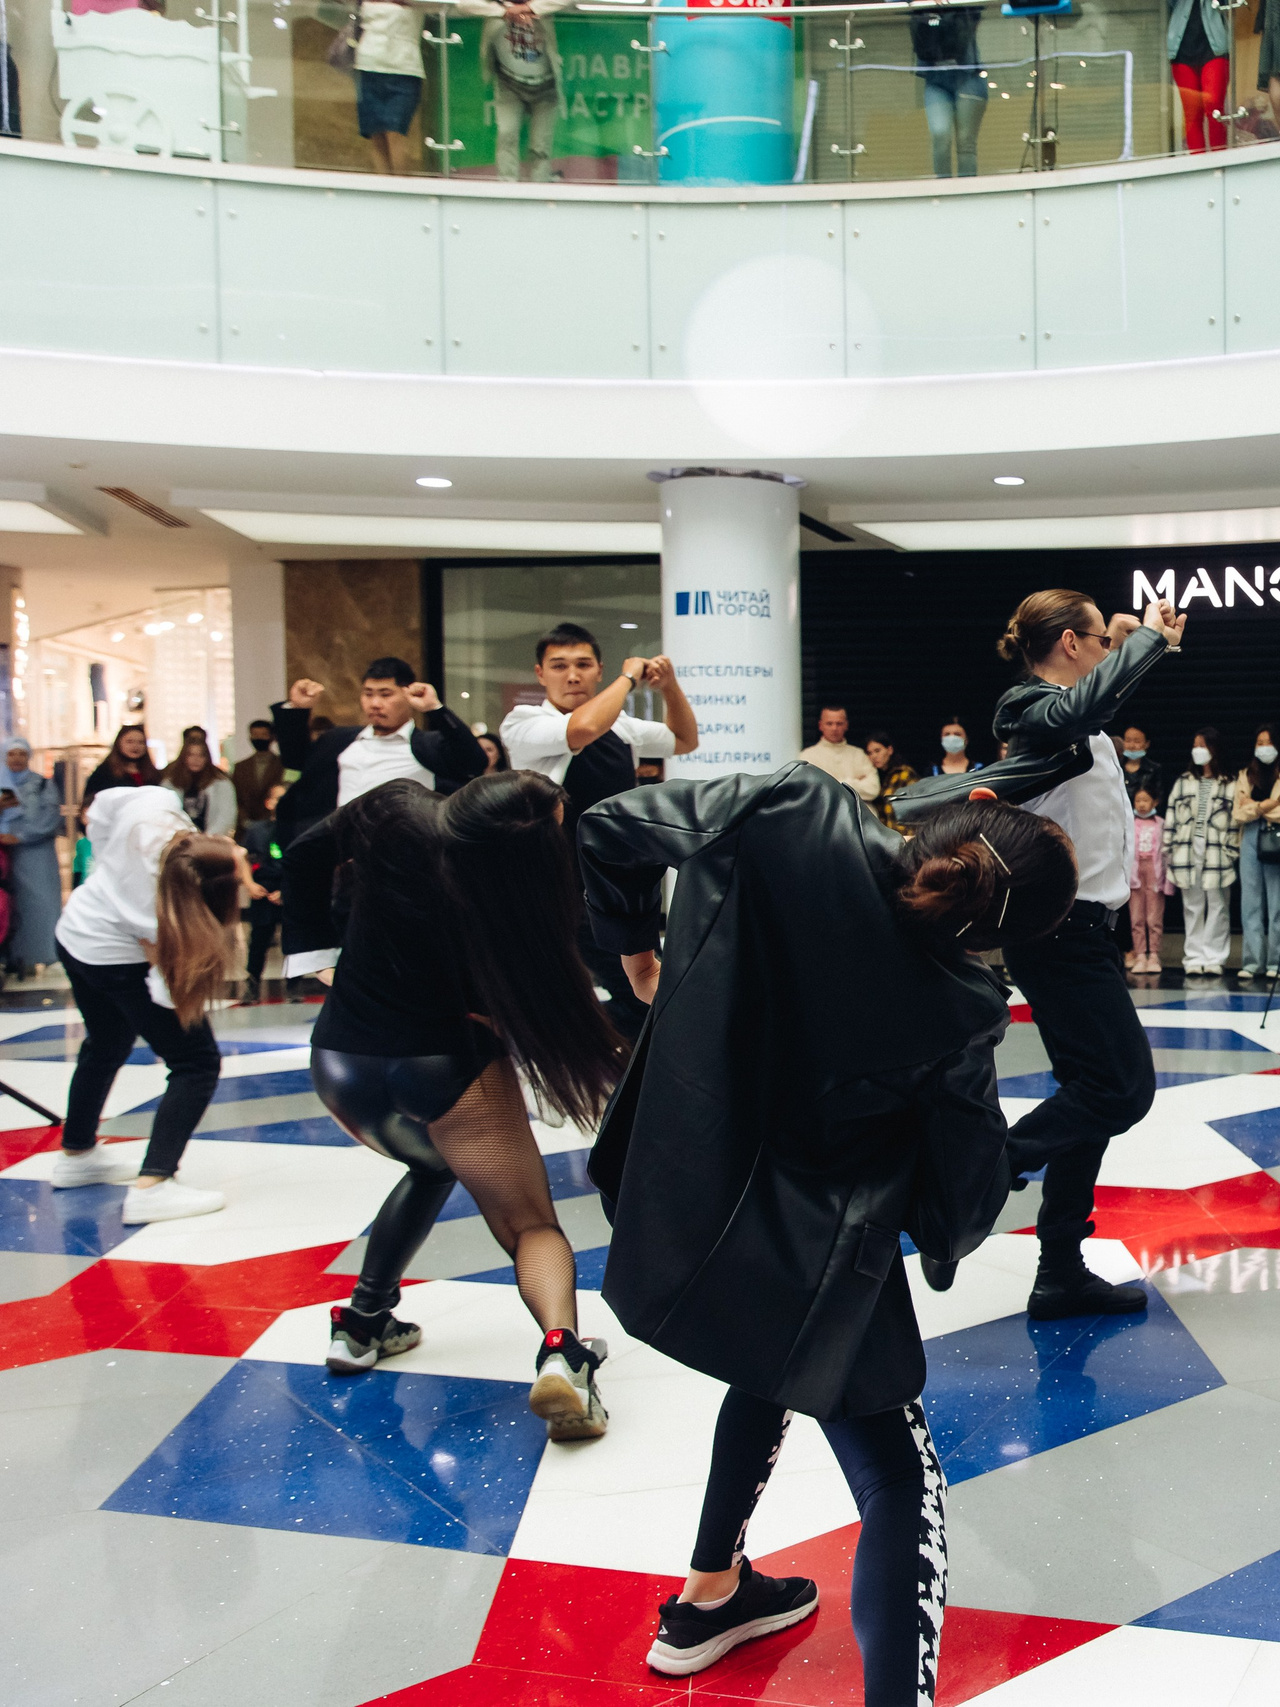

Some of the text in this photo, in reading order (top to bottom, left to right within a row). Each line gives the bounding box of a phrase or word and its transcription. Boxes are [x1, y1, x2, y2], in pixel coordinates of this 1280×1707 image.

[566, 53, 650, 81] ЛАВН
[716, 589, 770, 603] ЧИТАЙ
[716, 603, 771, 618] ГОРОД
[676, 665, 773, 678] БЕСТСЕЛЛЕРЫ
[686, 694, 746, 705] ОВИНКИ
[697, 723, 745, 735] ДАРКИ
[677, 751, 771, 763] КАНЦЕЛЯРИЯ
